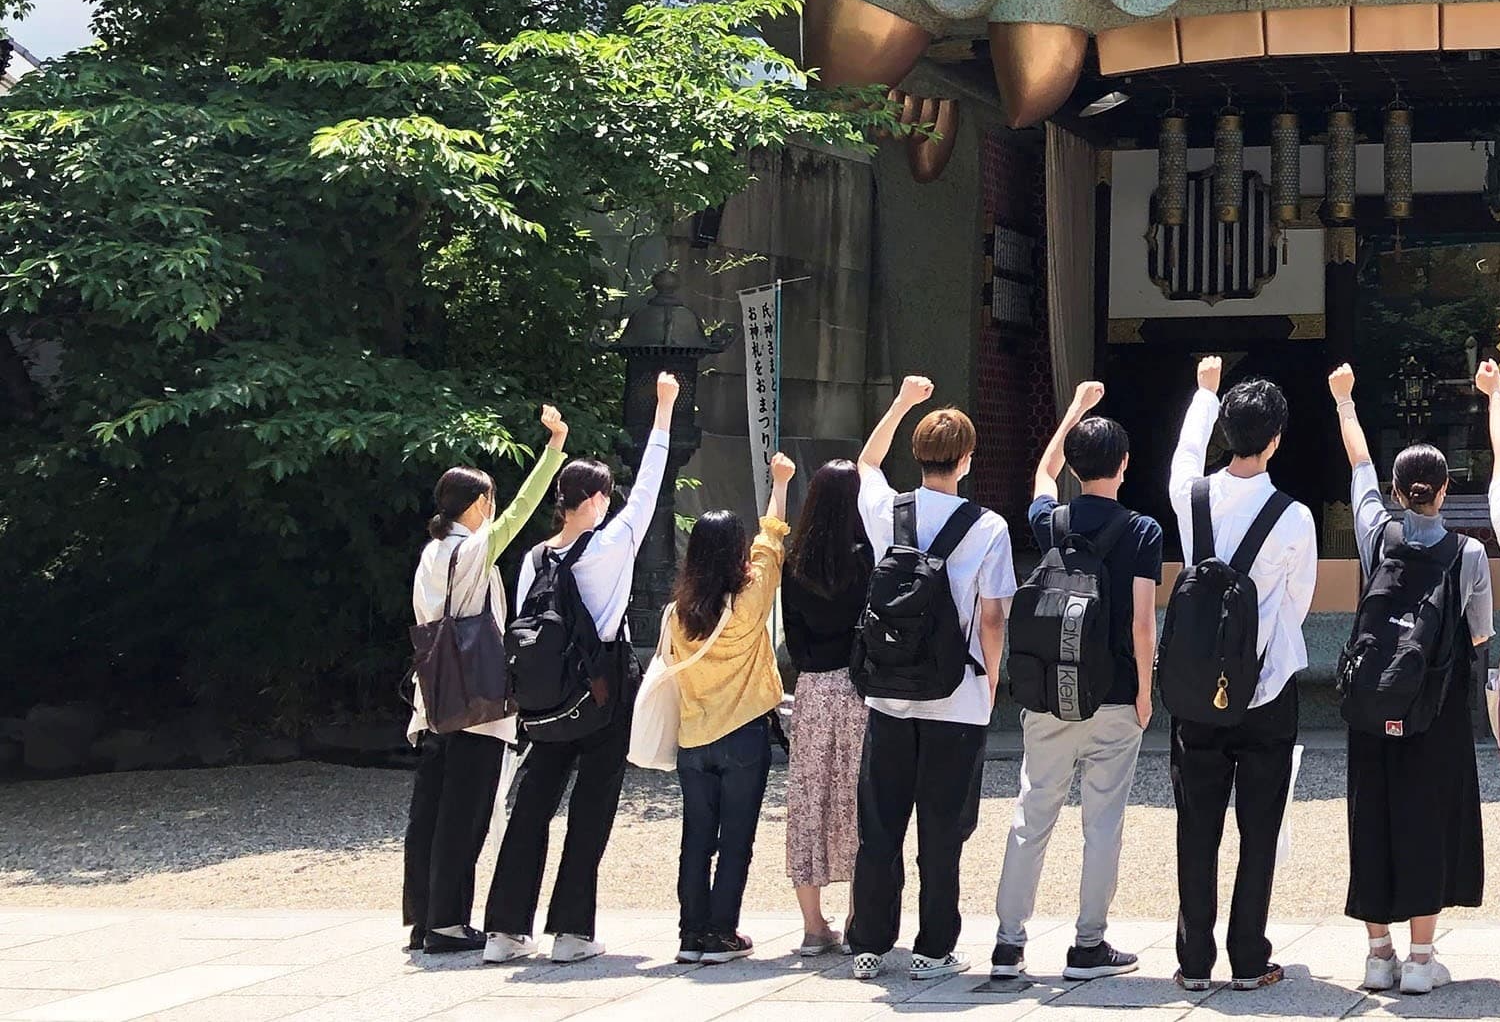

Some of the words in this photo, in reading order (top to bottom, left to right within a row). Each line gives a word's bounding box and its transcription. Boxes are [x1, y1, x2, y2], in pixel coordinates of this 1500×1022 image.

[749, 306, 771, 484] お神札をおまつりし
[1062, 602, 1084, 664] Calvin
[1058, 669, 1077, 713] Klein
